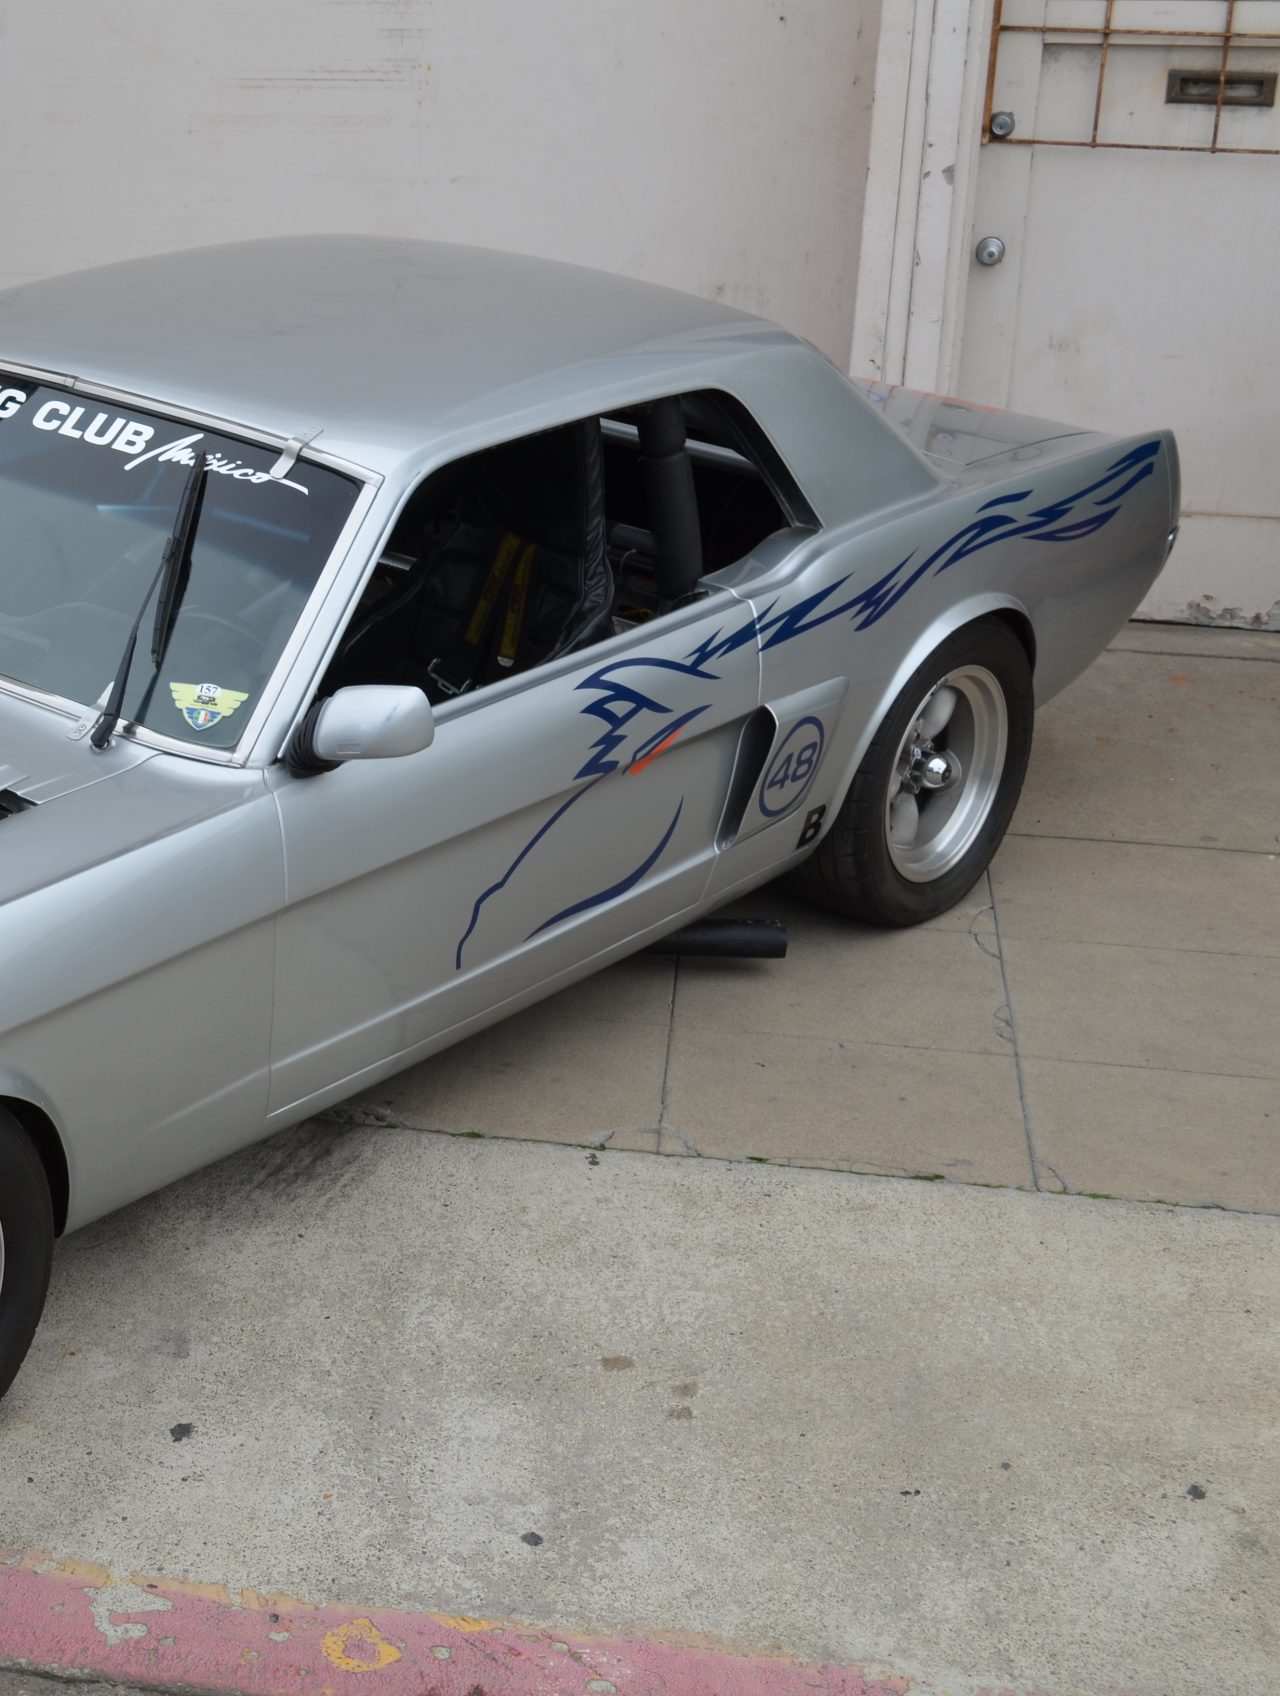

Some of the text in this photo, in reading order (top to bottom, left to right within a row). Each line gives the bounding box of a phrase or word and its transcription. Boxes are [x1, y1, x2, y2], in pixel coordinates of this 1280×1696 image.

[32, 400, 155, 455] CLUB
[199, 684, 219, 696] 157
[766, 741, 819, 789] 48
[795, 804, 826, 849] B
